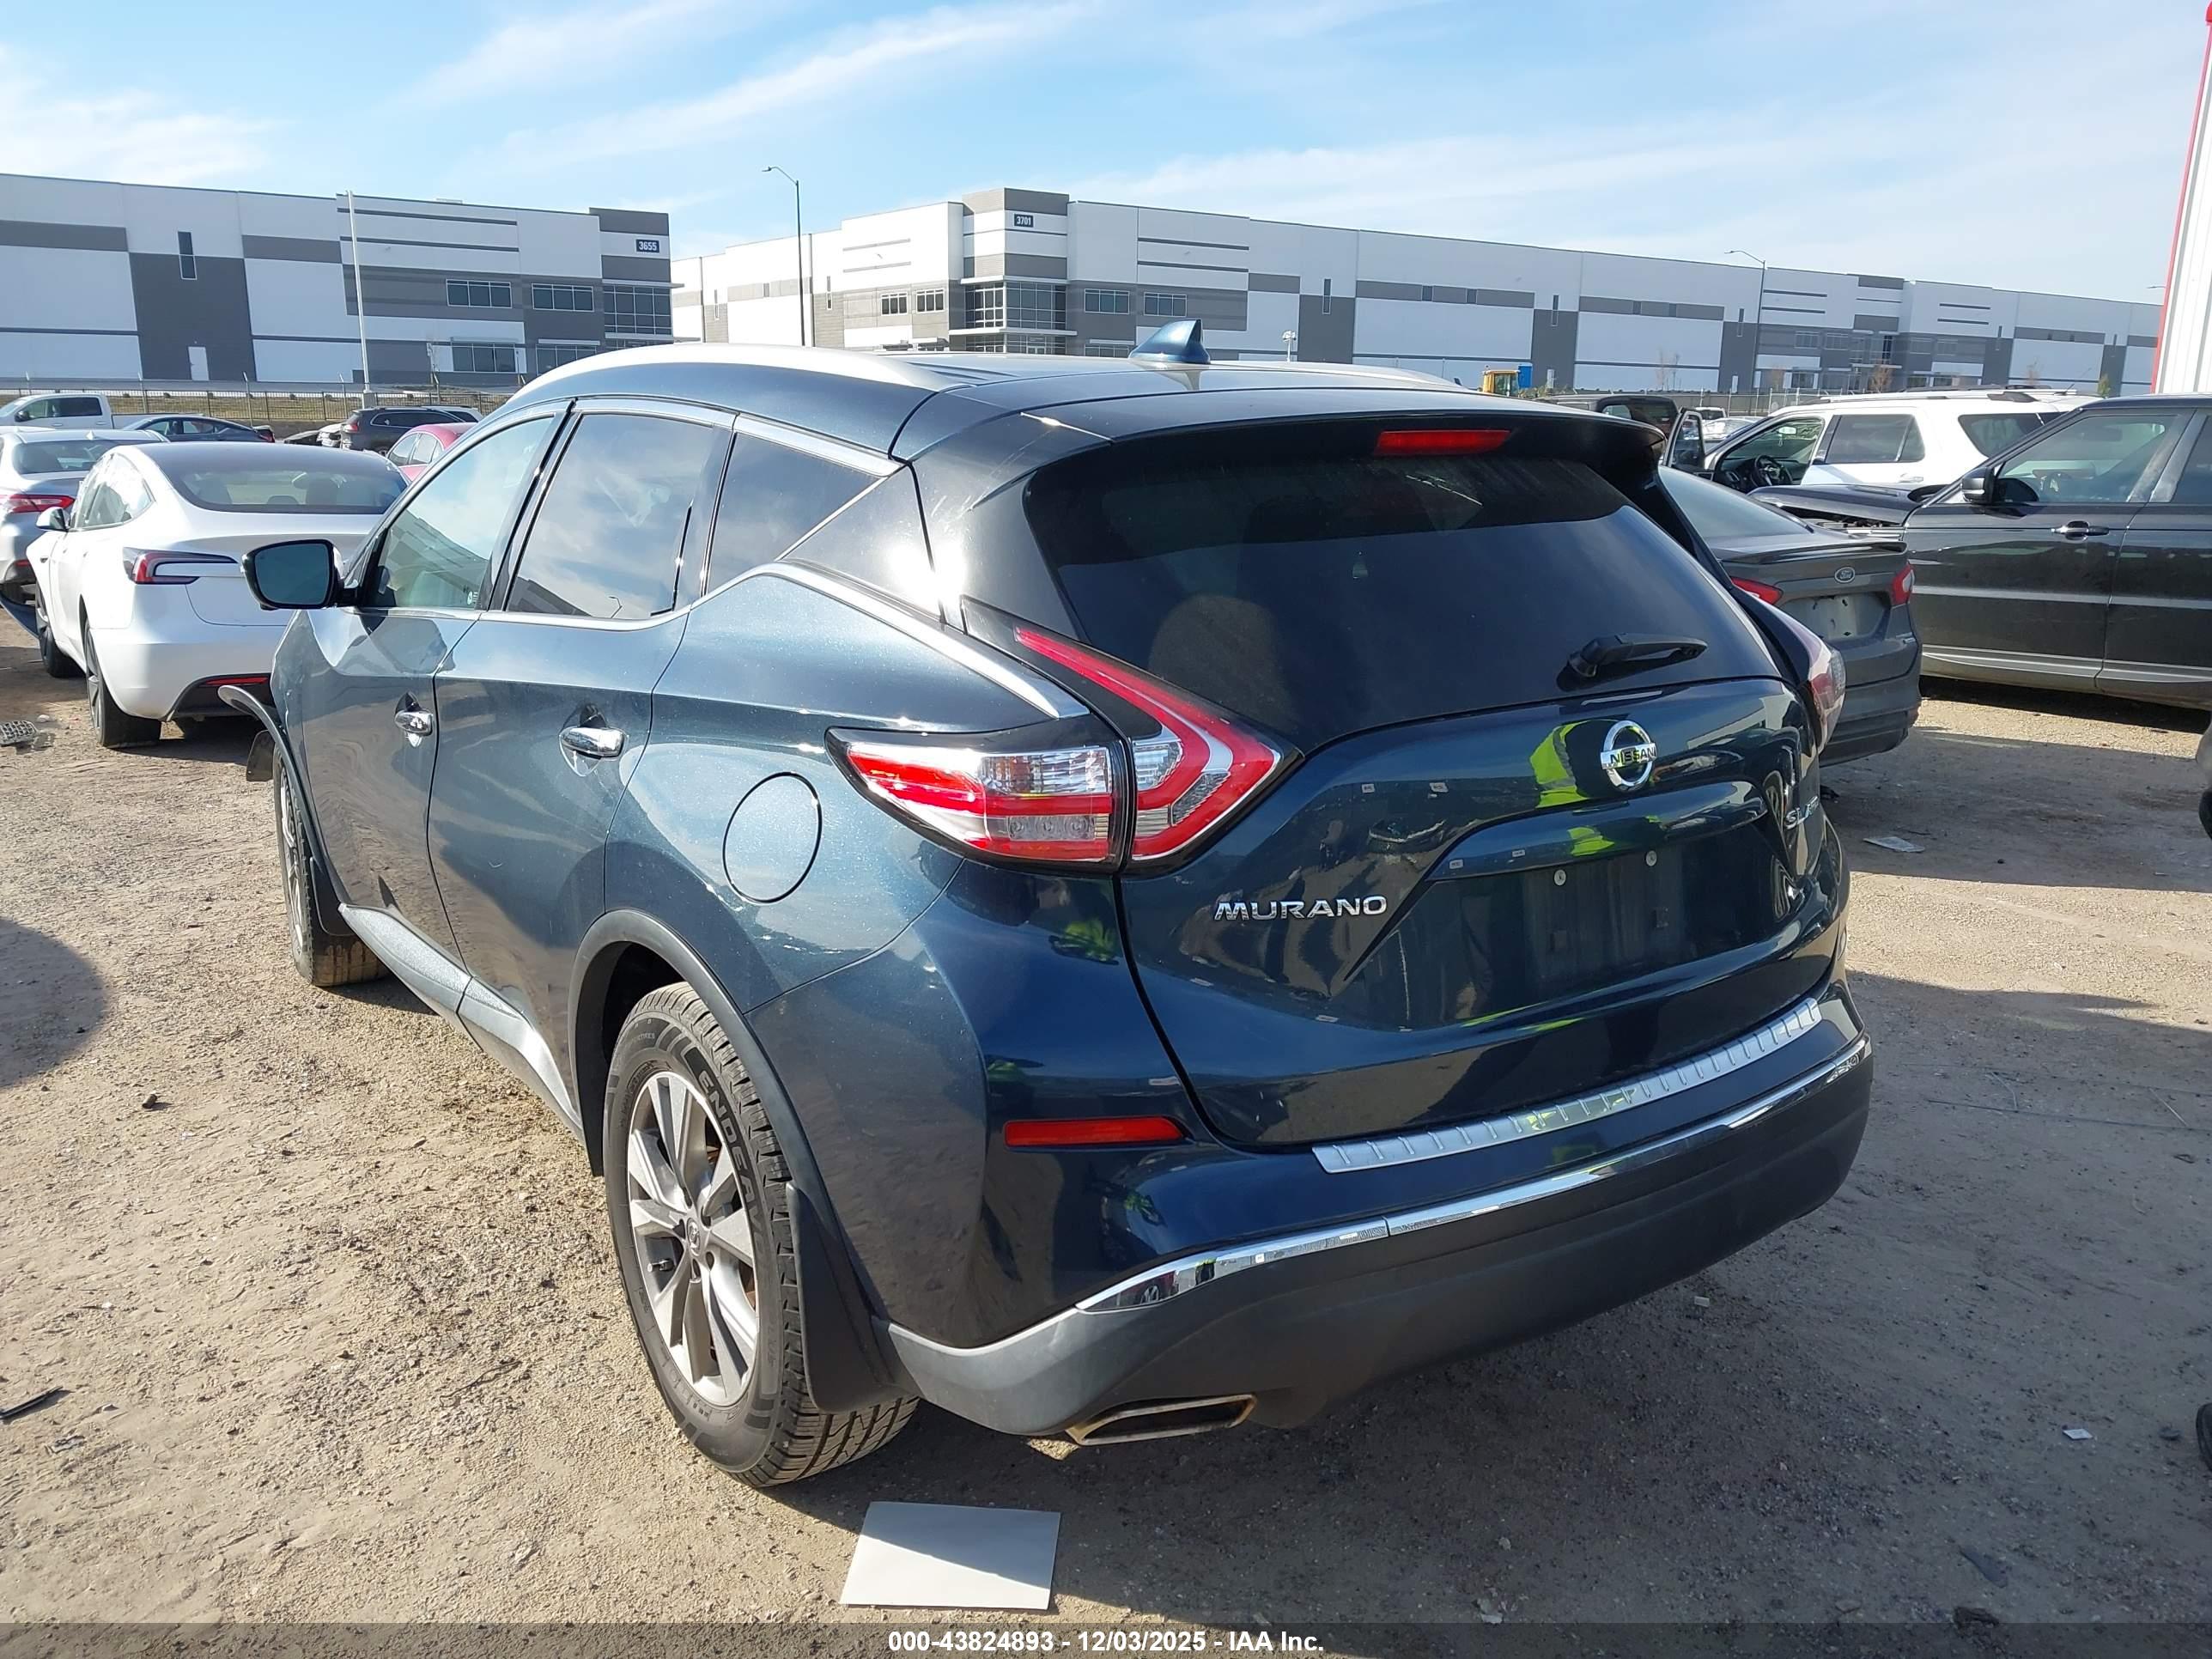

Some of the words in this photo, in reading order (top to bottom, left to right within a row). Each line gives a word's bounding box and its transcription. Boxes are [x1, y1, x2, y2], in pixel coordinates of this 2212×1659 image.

[1016, 216, 1031, 226] 3701
[638, 241, 657, 251] 3655
[1609, 746, 1656, 766] NISSAN
[1214, 896, 1388, 921] MURANO
